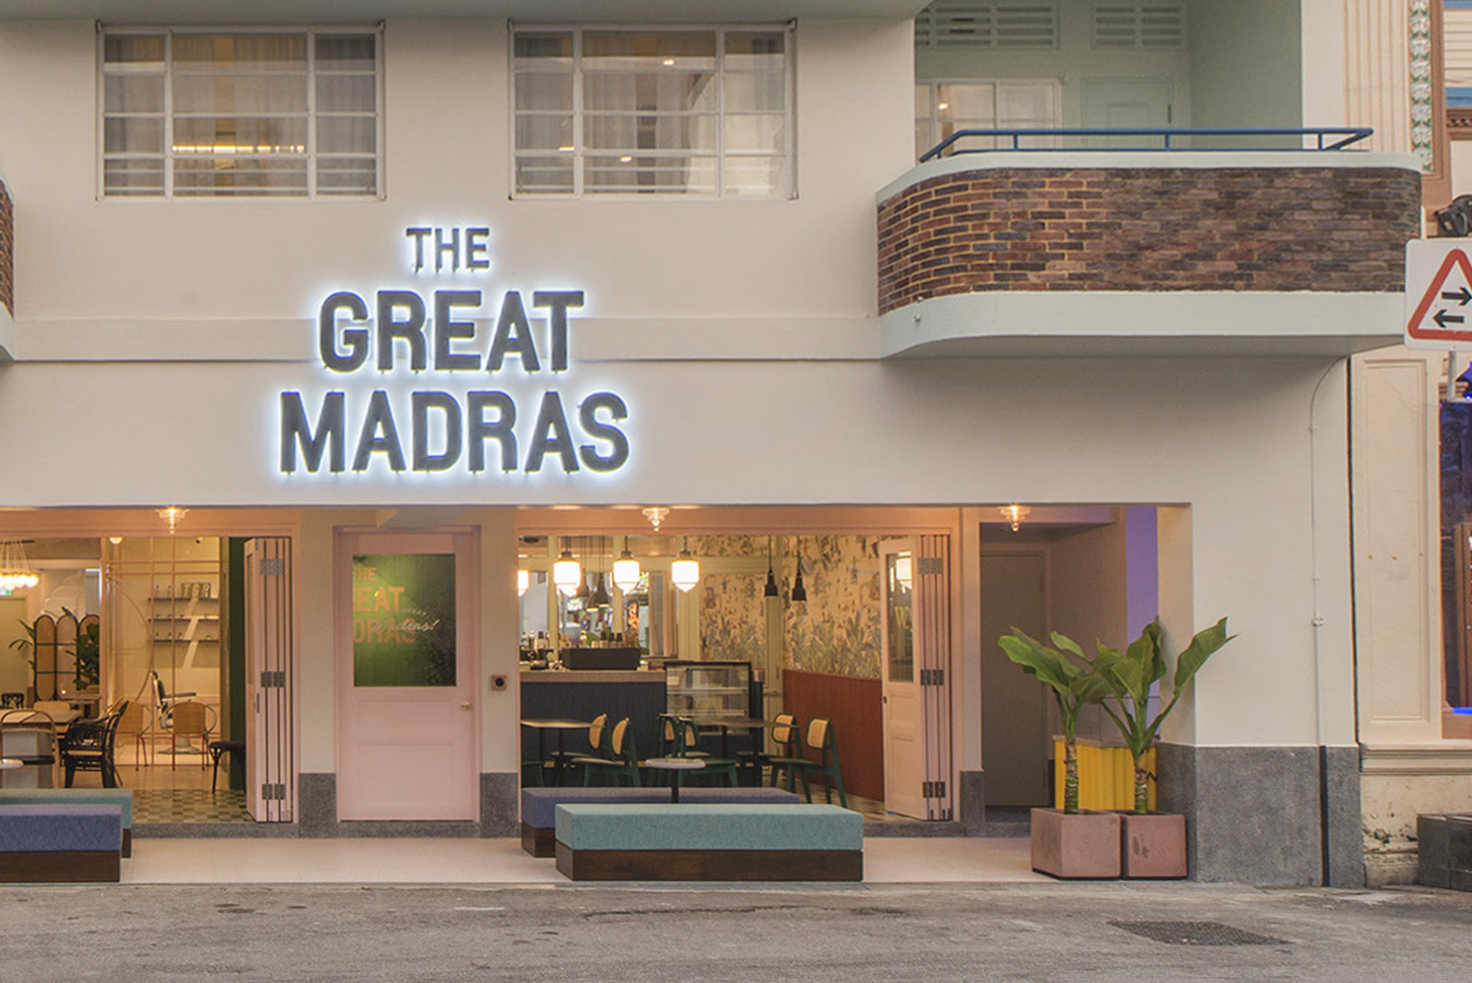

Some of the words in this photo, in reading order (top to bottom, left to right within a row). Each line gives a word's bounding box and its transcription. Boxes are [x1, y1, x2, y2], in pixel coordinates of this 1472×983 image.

[406, 227, 490, 270] THE
[319, 291, 584, 373] GREAT
[280, 391, 629, 473] MADRAS
[353, 585, 405, 612] EAT
